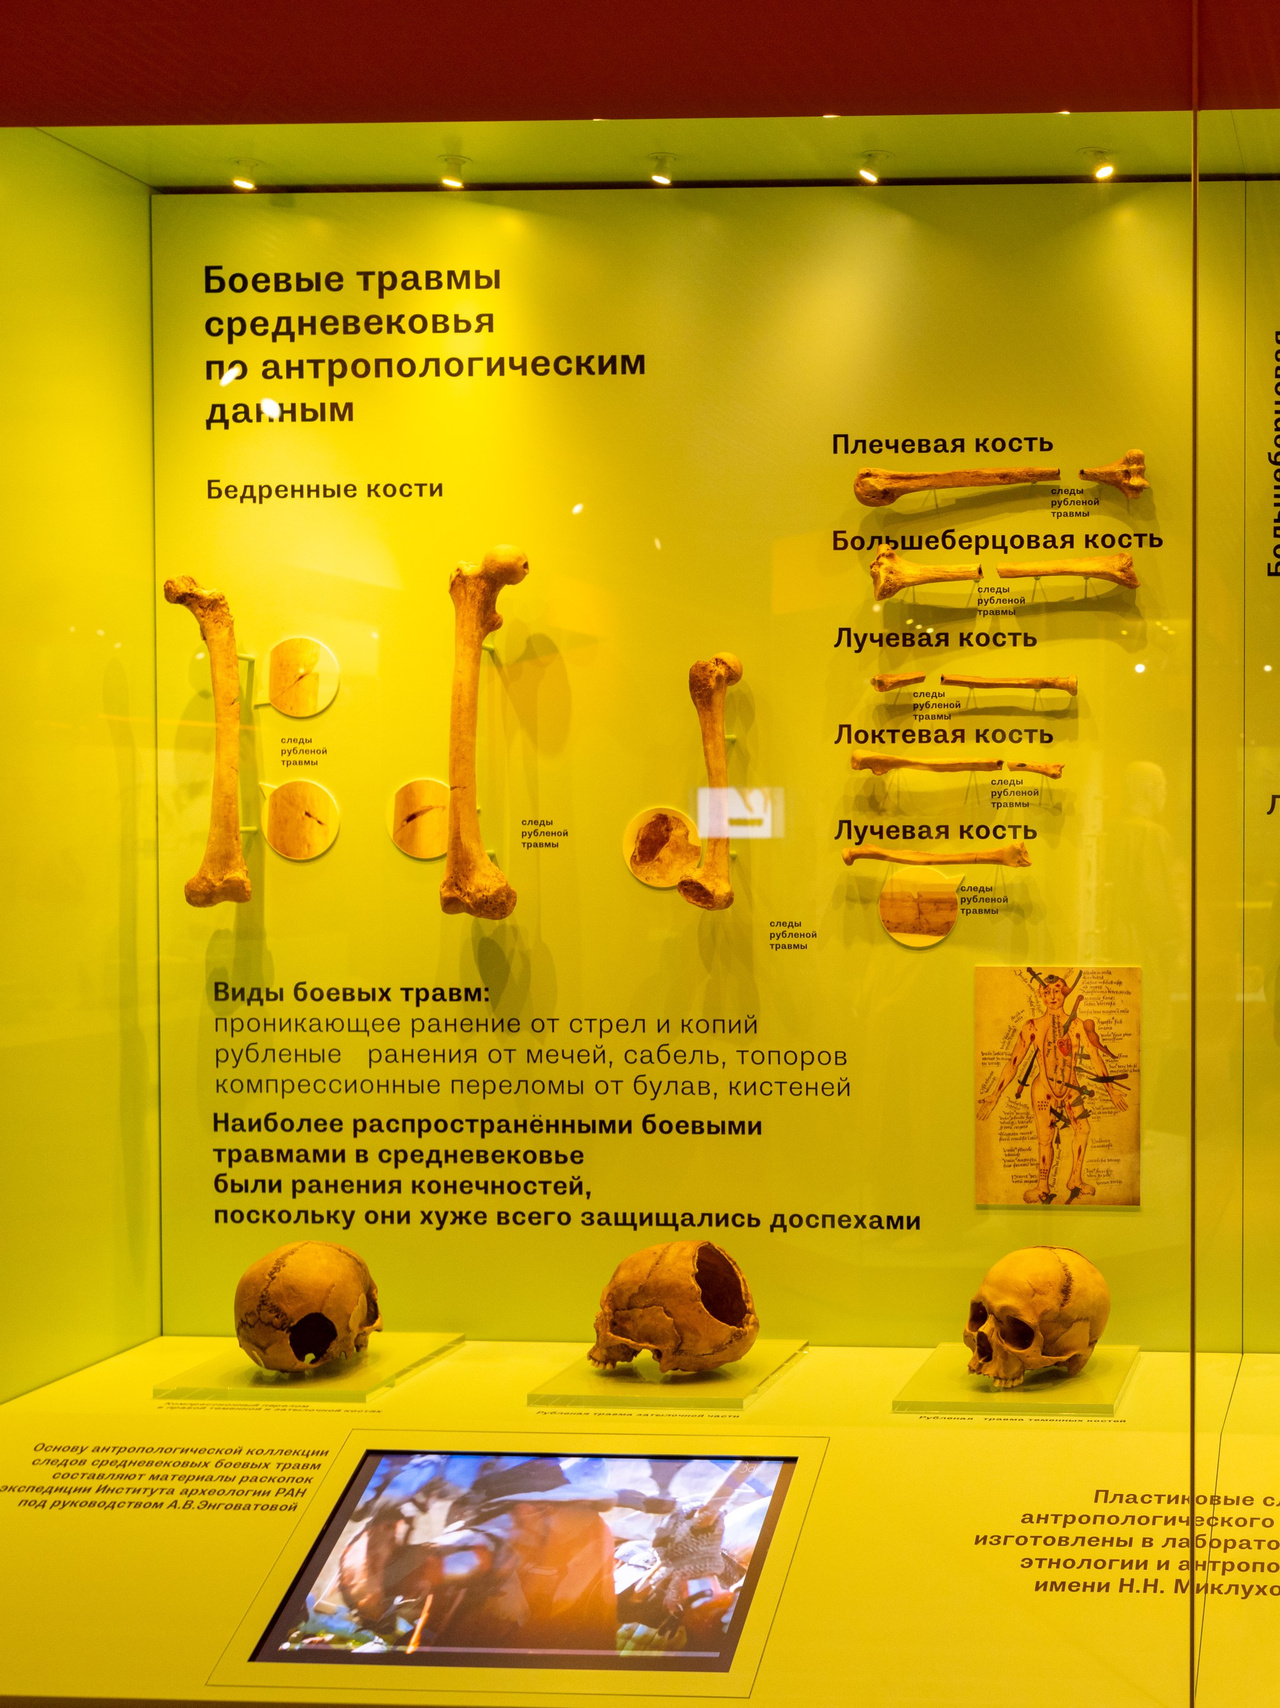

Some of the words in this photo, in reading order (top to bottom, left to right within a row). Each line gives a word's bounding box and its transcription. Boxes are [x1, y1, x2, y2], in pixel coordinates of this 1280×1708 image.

[205, 266, 343, 293] Боевые
[356, 270, 500, 299] травмы
[205, 314, 493, 344] средневековья
[205, 360, 248, 380] по
[262, 355, 645, 386] антропологическим
[833, 434, 964, 454] Плечевая
[976, 437, 1053, 452] кость
[208, 480, 357, 504] Бедренные
[367, 483, 442, 497] кости
[1051, 488, 1083, 496] следы
[1051, 497, 1099, 508] рубленой
[1051, 510, 1089, 519] травмы
[833, 529, 1074, 555] Большеберцовая
[1085, 533, 1163, 548] кость
[978, 586, 1009, 594] следы
[978, 595, 1025, 606] рубленой
[977, 608, 1016, 617] травмы
[834, 628, 949, 653] Лучевая
[960, 632, 1037, 647] кость
[913, 691, 945, 699] следы
[913, 700, 961, 711] рубленой
[913, 712, 953, 722] травмы
[834, 724, 965, 744] Локтевая
[976, 729, 1053, 743] кость
[281, 737, 312, 745] следы
[281, 746, 327, 756] рубленой
[282, 759, 318, 767] травмы
[991, 778, 1023, 787] следы
[991, 787, 1039, 799] рубленой
[991, 801, 1029, 810] травмы
[522, 819, 553, 827] следы
[522, 828, 568, 839] рубленой
[834, 820, 949, 845] Лучевая
[960, 825, 1037, 839] кость
[522, 841, 558, 849] травмы
[960, 885, 992, 893] следы
[961, 894, 1008, 905] рубленой
[960, 907, 998, 916] травмы
[770, 920, 801, 929] следы
[770, 929, 817, 940] рубленой
[770, 943, 807, 951] травмы
[214, 982, 283, 1006] Виды
[294, 981, 391, 1002] боевых
[400, 987, 489, 1007] травм:
[216, 1079, 440, 1099] компрессионные
[452, 1079, 583, 1100] переломы
[595, 1080, 623, 1095] от
[634, 1074, 717, 1101] булав,
[730, 1077, 850, 1096] кистеней
[214, 1112, 343, 1132] Наиболее
[353, 1114, 632, 1139] распространёнными
[642, 1114, 761, 1135] боевыми
[34, 1442, 89, 1455] Основу
[92, 1443, 242, 1455] антропологической
[246, 1448, 329, 1458] коллекции
[1094, 1489, 1254, 1506] Пластиковые
